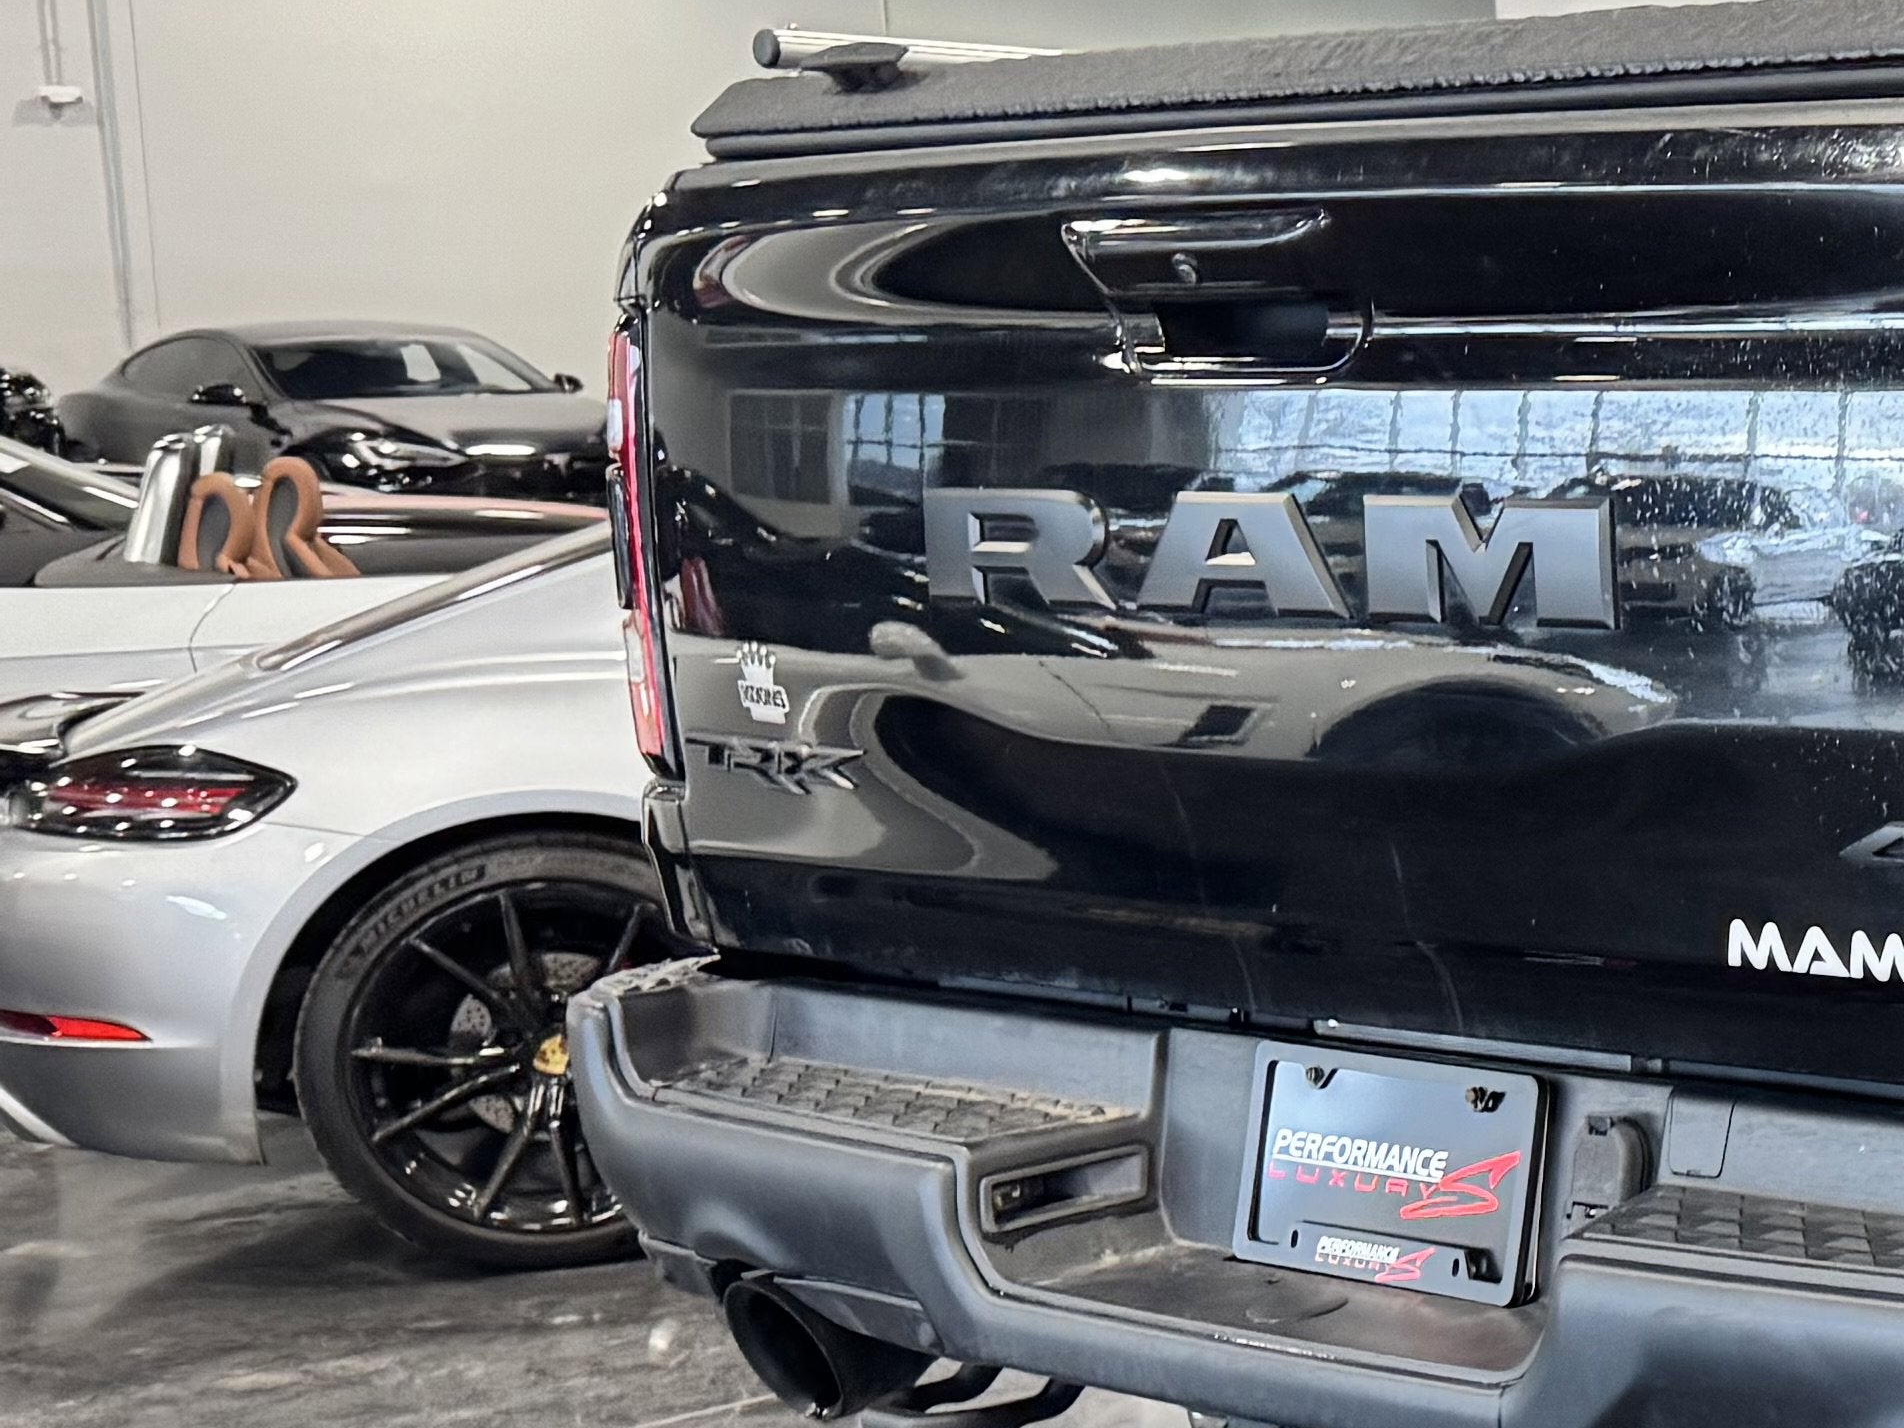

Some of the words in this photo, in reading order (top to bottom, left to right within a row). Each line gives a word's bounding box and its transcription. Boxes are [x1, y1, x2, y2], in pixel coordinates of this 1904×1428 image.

[924, 488, 1622, 631] RAM
[1273, 1128, 1449, 1178] PERFORMANCE
[1316, 1236, 1401, 1264] PERFORMANCE
